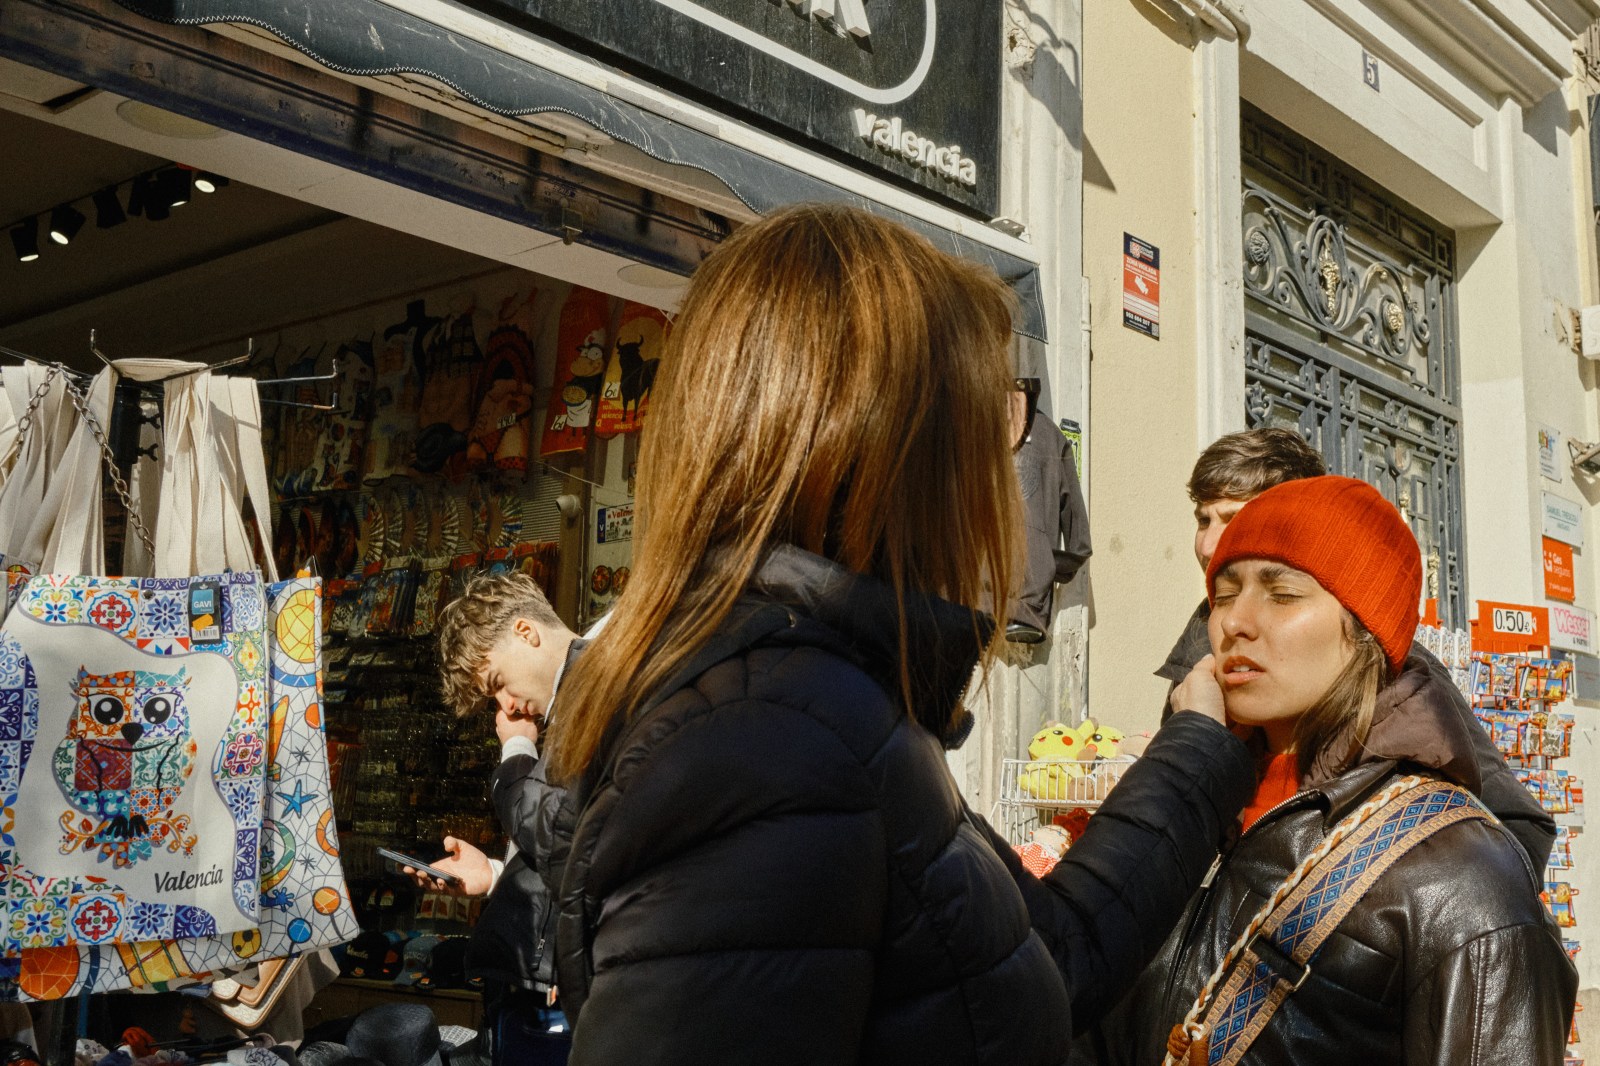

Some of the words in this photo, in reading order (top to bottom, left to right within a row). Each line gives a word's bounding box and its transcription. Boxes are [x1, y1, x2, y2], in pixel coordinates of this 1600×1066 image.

[1366, 56, 1376, 85] 5
[851, 108, 977, 185] valencia
[193, 600, 212, 608] GAVI
[1495, 609, 1530, 633] 0.50€
[154, 865, 224, 894] Valencia
